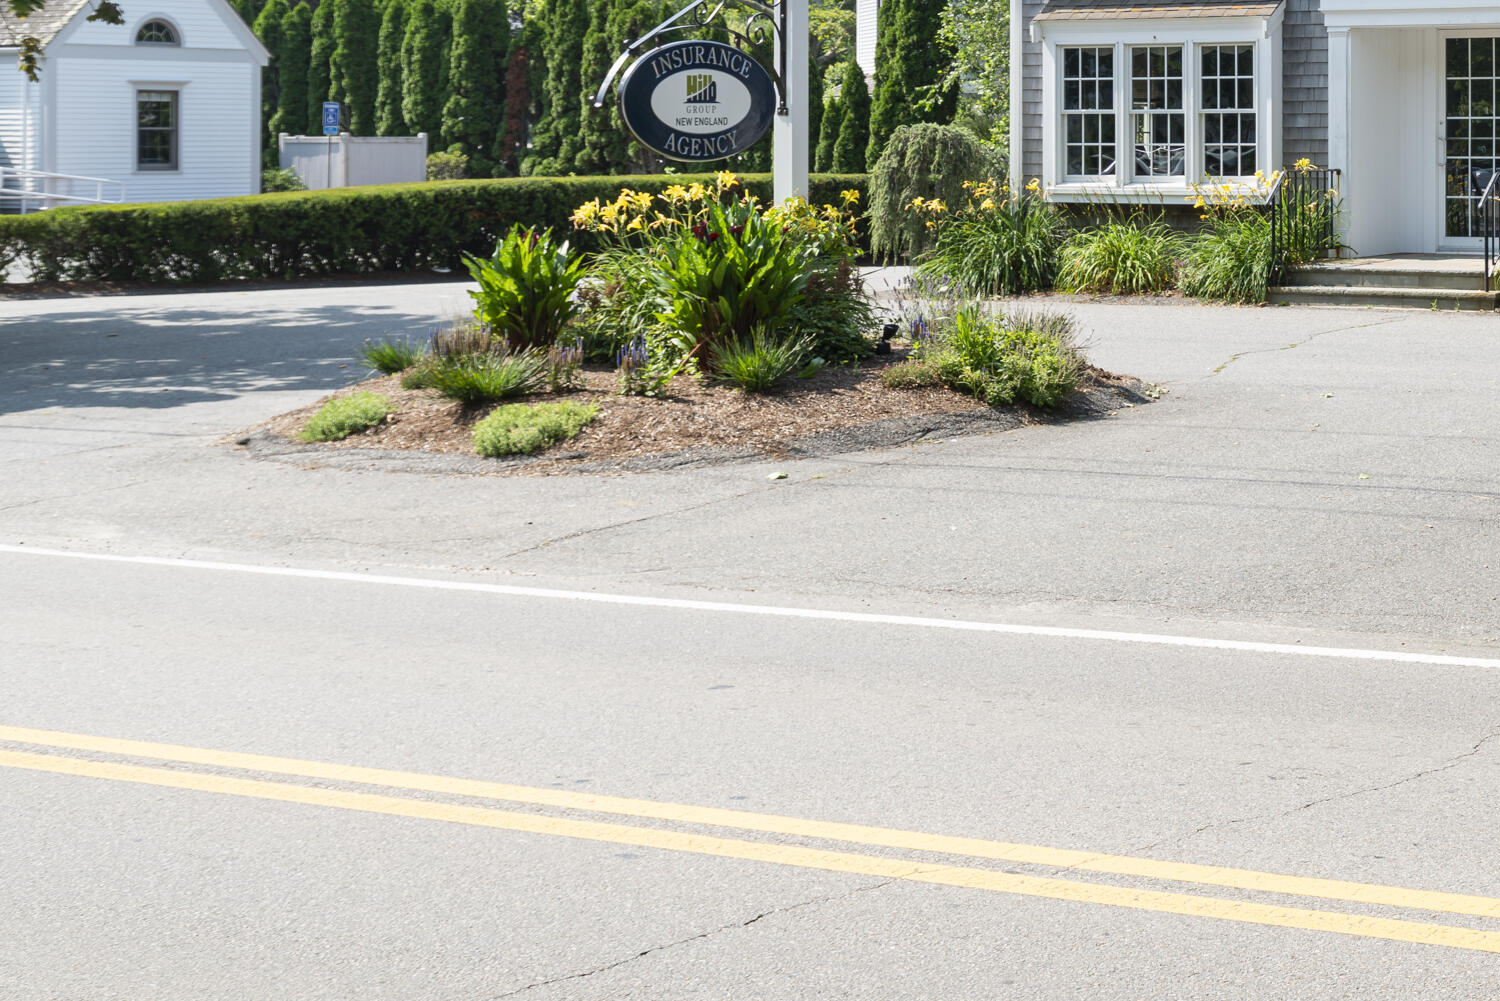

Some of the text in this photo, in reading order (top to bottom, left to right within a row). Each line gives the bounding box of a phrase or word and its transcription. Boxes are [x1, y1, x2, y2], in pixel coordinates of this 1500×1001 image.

[651, 46, 753, 79] INSURANCE
[686, 105, 717, 114] GROUP
[675, 116, 729, 126] NEW ENGLAND
[664, 130, 737, 157] AGENCY
